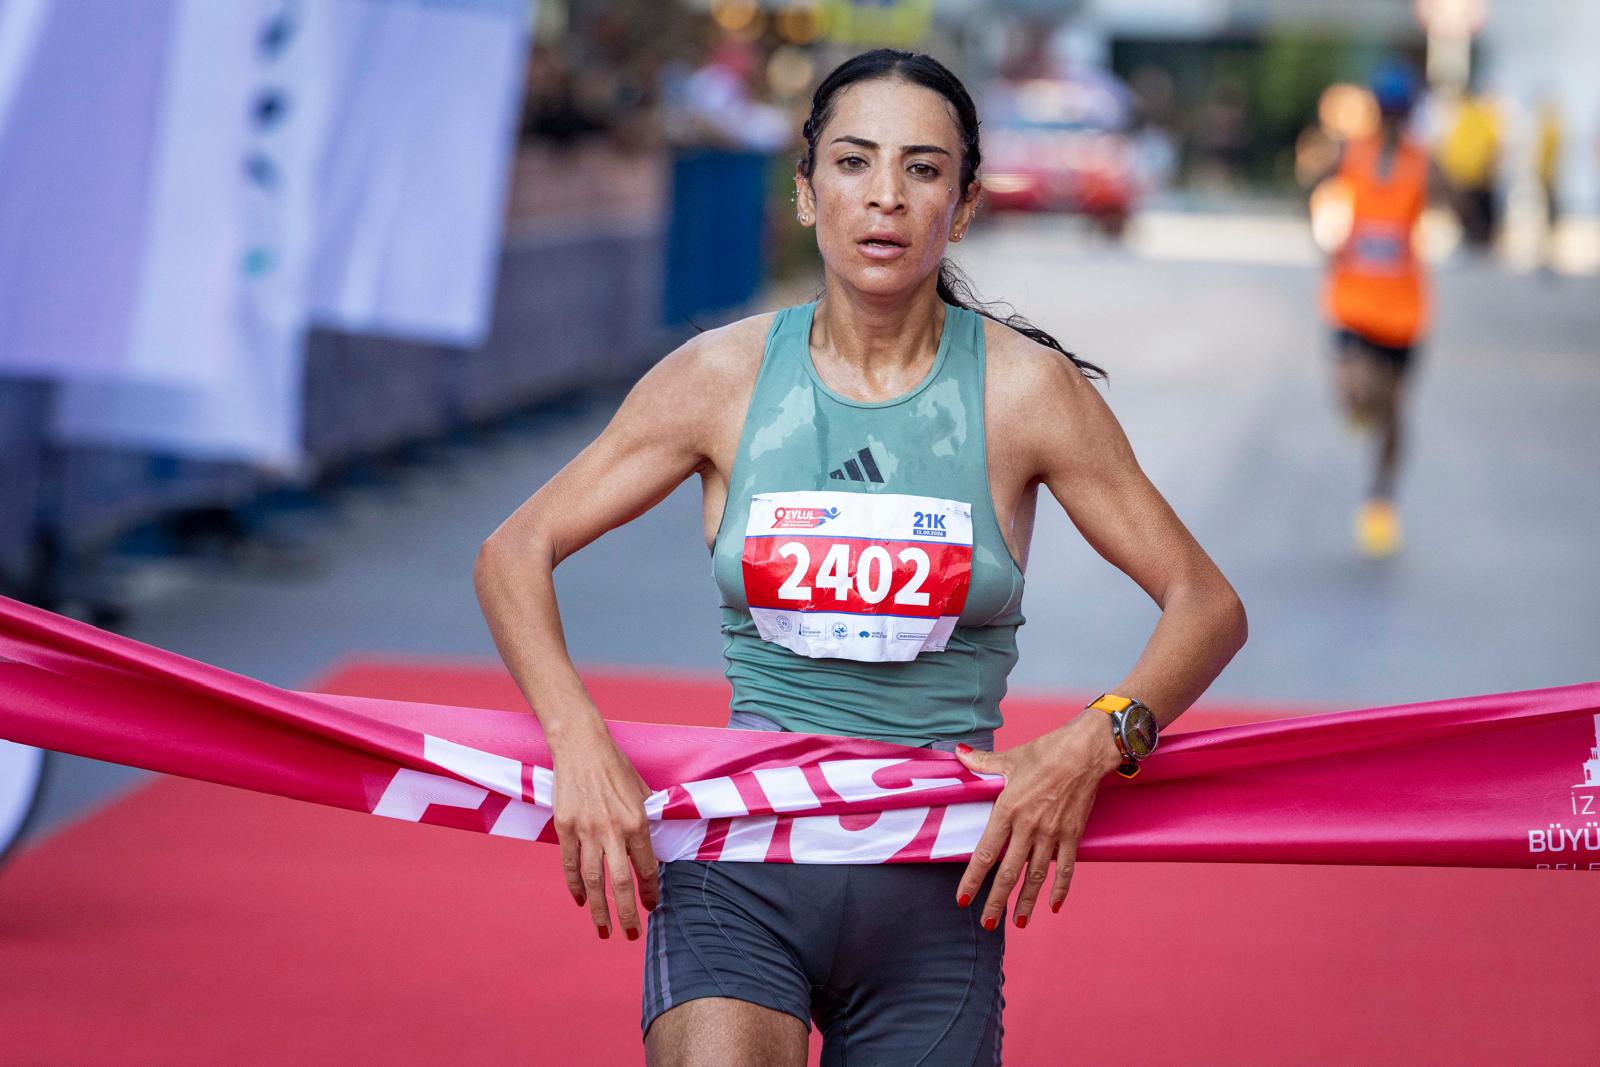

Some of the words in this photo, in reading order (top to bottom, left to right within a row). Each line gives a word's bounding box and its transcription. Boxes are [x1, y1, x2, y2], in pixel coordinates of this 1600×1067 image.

[913, 511, 946, 529] 21K
[777, 541, 931, 606] 2402
[1528, 821, 1600, 853] BÜYÜ
